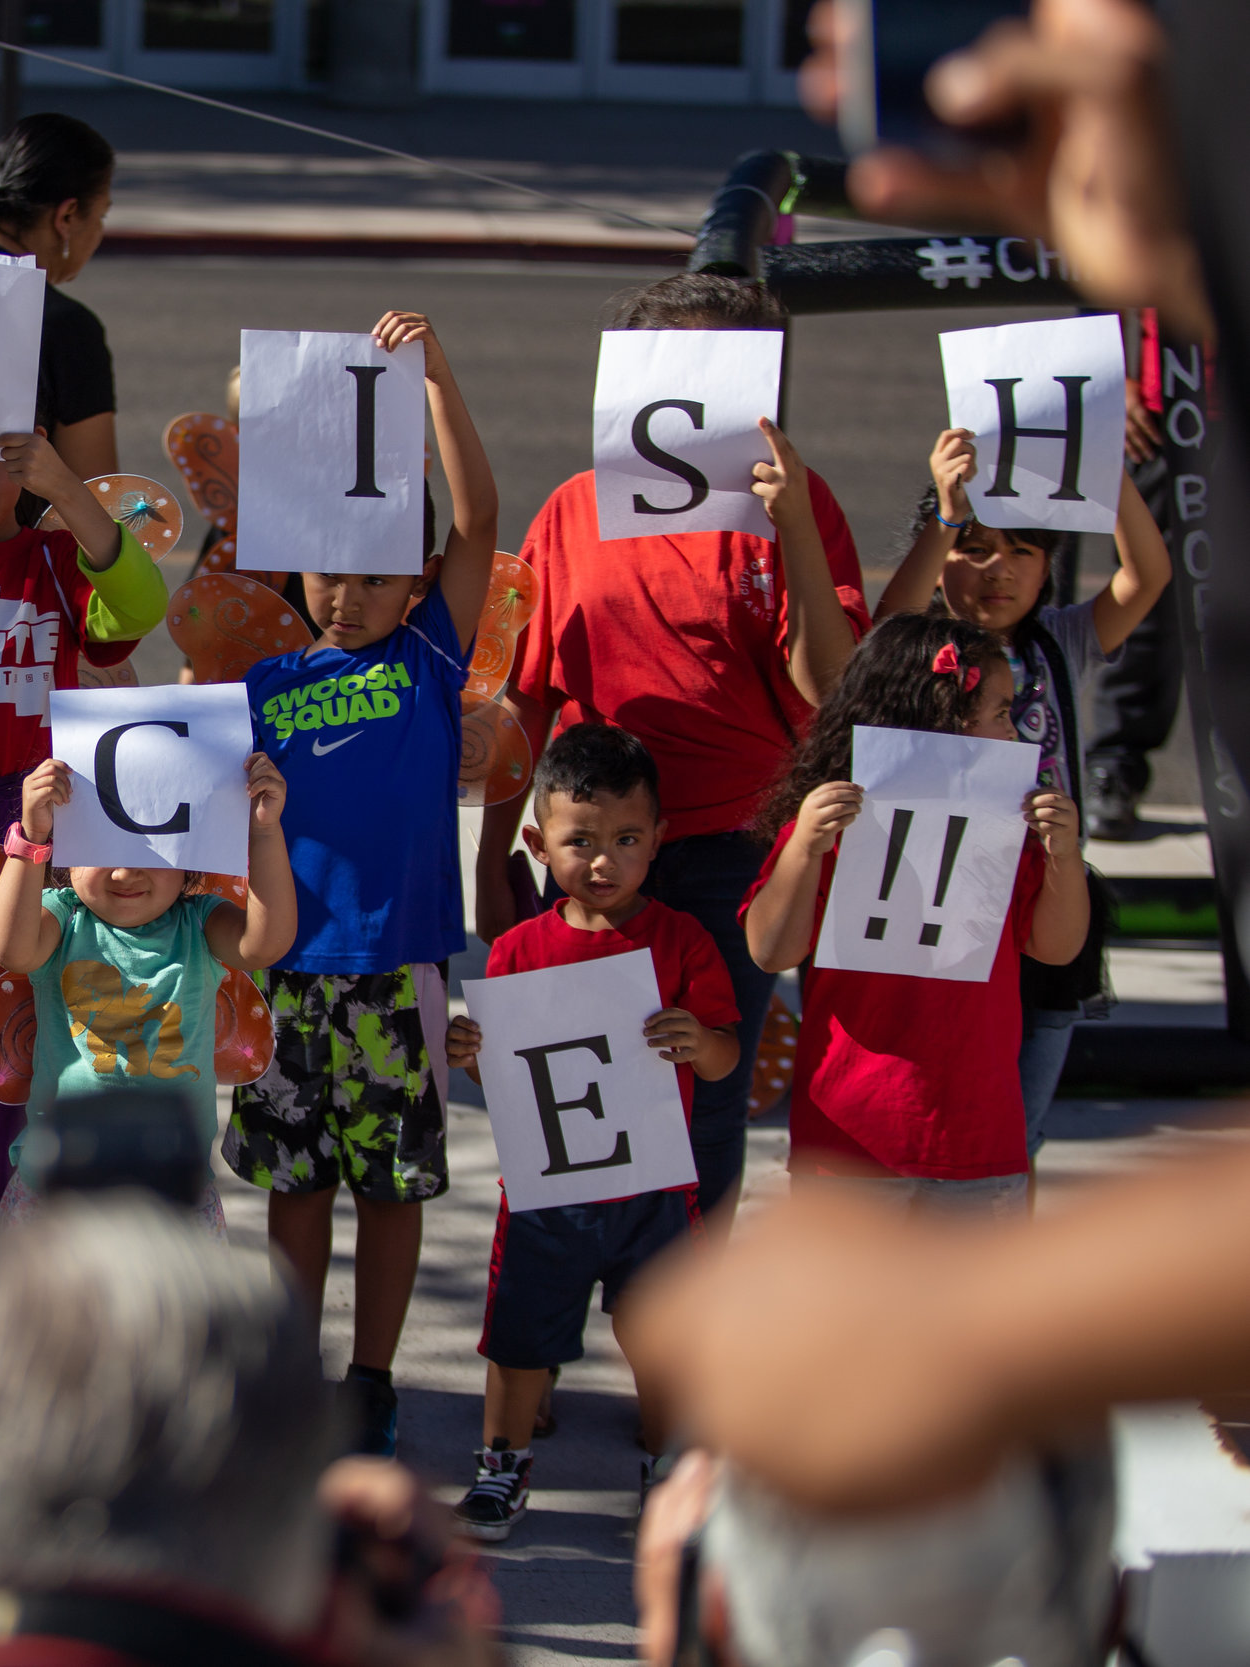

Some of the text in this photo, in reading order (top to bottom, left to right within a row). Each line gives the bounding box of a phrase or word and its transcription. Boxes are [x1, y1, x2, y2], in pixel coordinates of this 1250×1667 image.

[915, 237, 1080, 289] #CH
[345, 366, 387, 498] I
[632, 399, 711, 515] S
[984, 375, 1092, 501] H
[739, 557, 768, 595] CITY OF
[743, 600, 773, 622] ARIZ
[262, 662, 412, 725] SWOOSH
[274, 690, 400, 740] SQUAD
[95, 721, 191, 835] C
[514, 1034, 632, 1177] E
